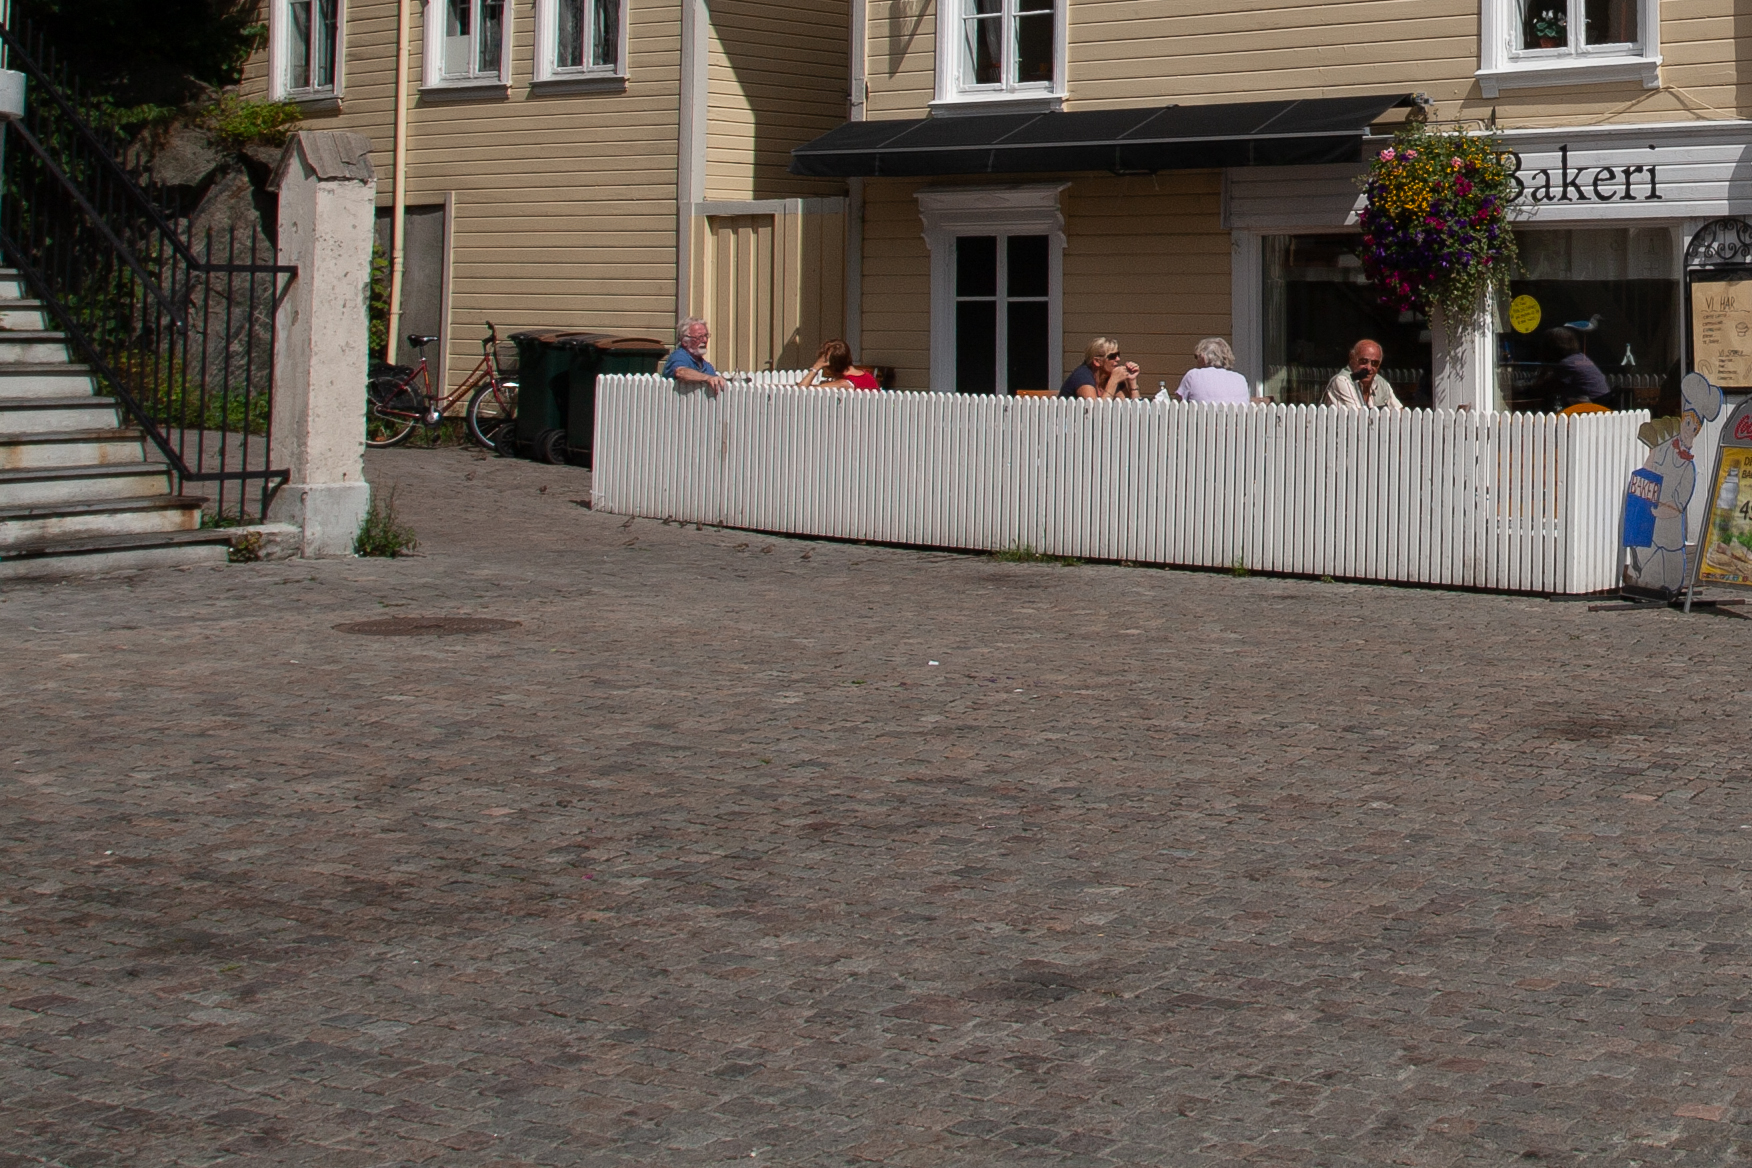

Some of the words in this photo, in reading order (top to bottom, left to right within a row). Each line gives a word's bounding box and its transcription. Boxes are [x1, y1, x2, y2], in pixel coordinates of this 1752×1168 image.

[1494, 143, 1663, 203] Bakeri
[1705, 296, 1715, 310] VI
[1720, 296, 1736, 311] HAR
